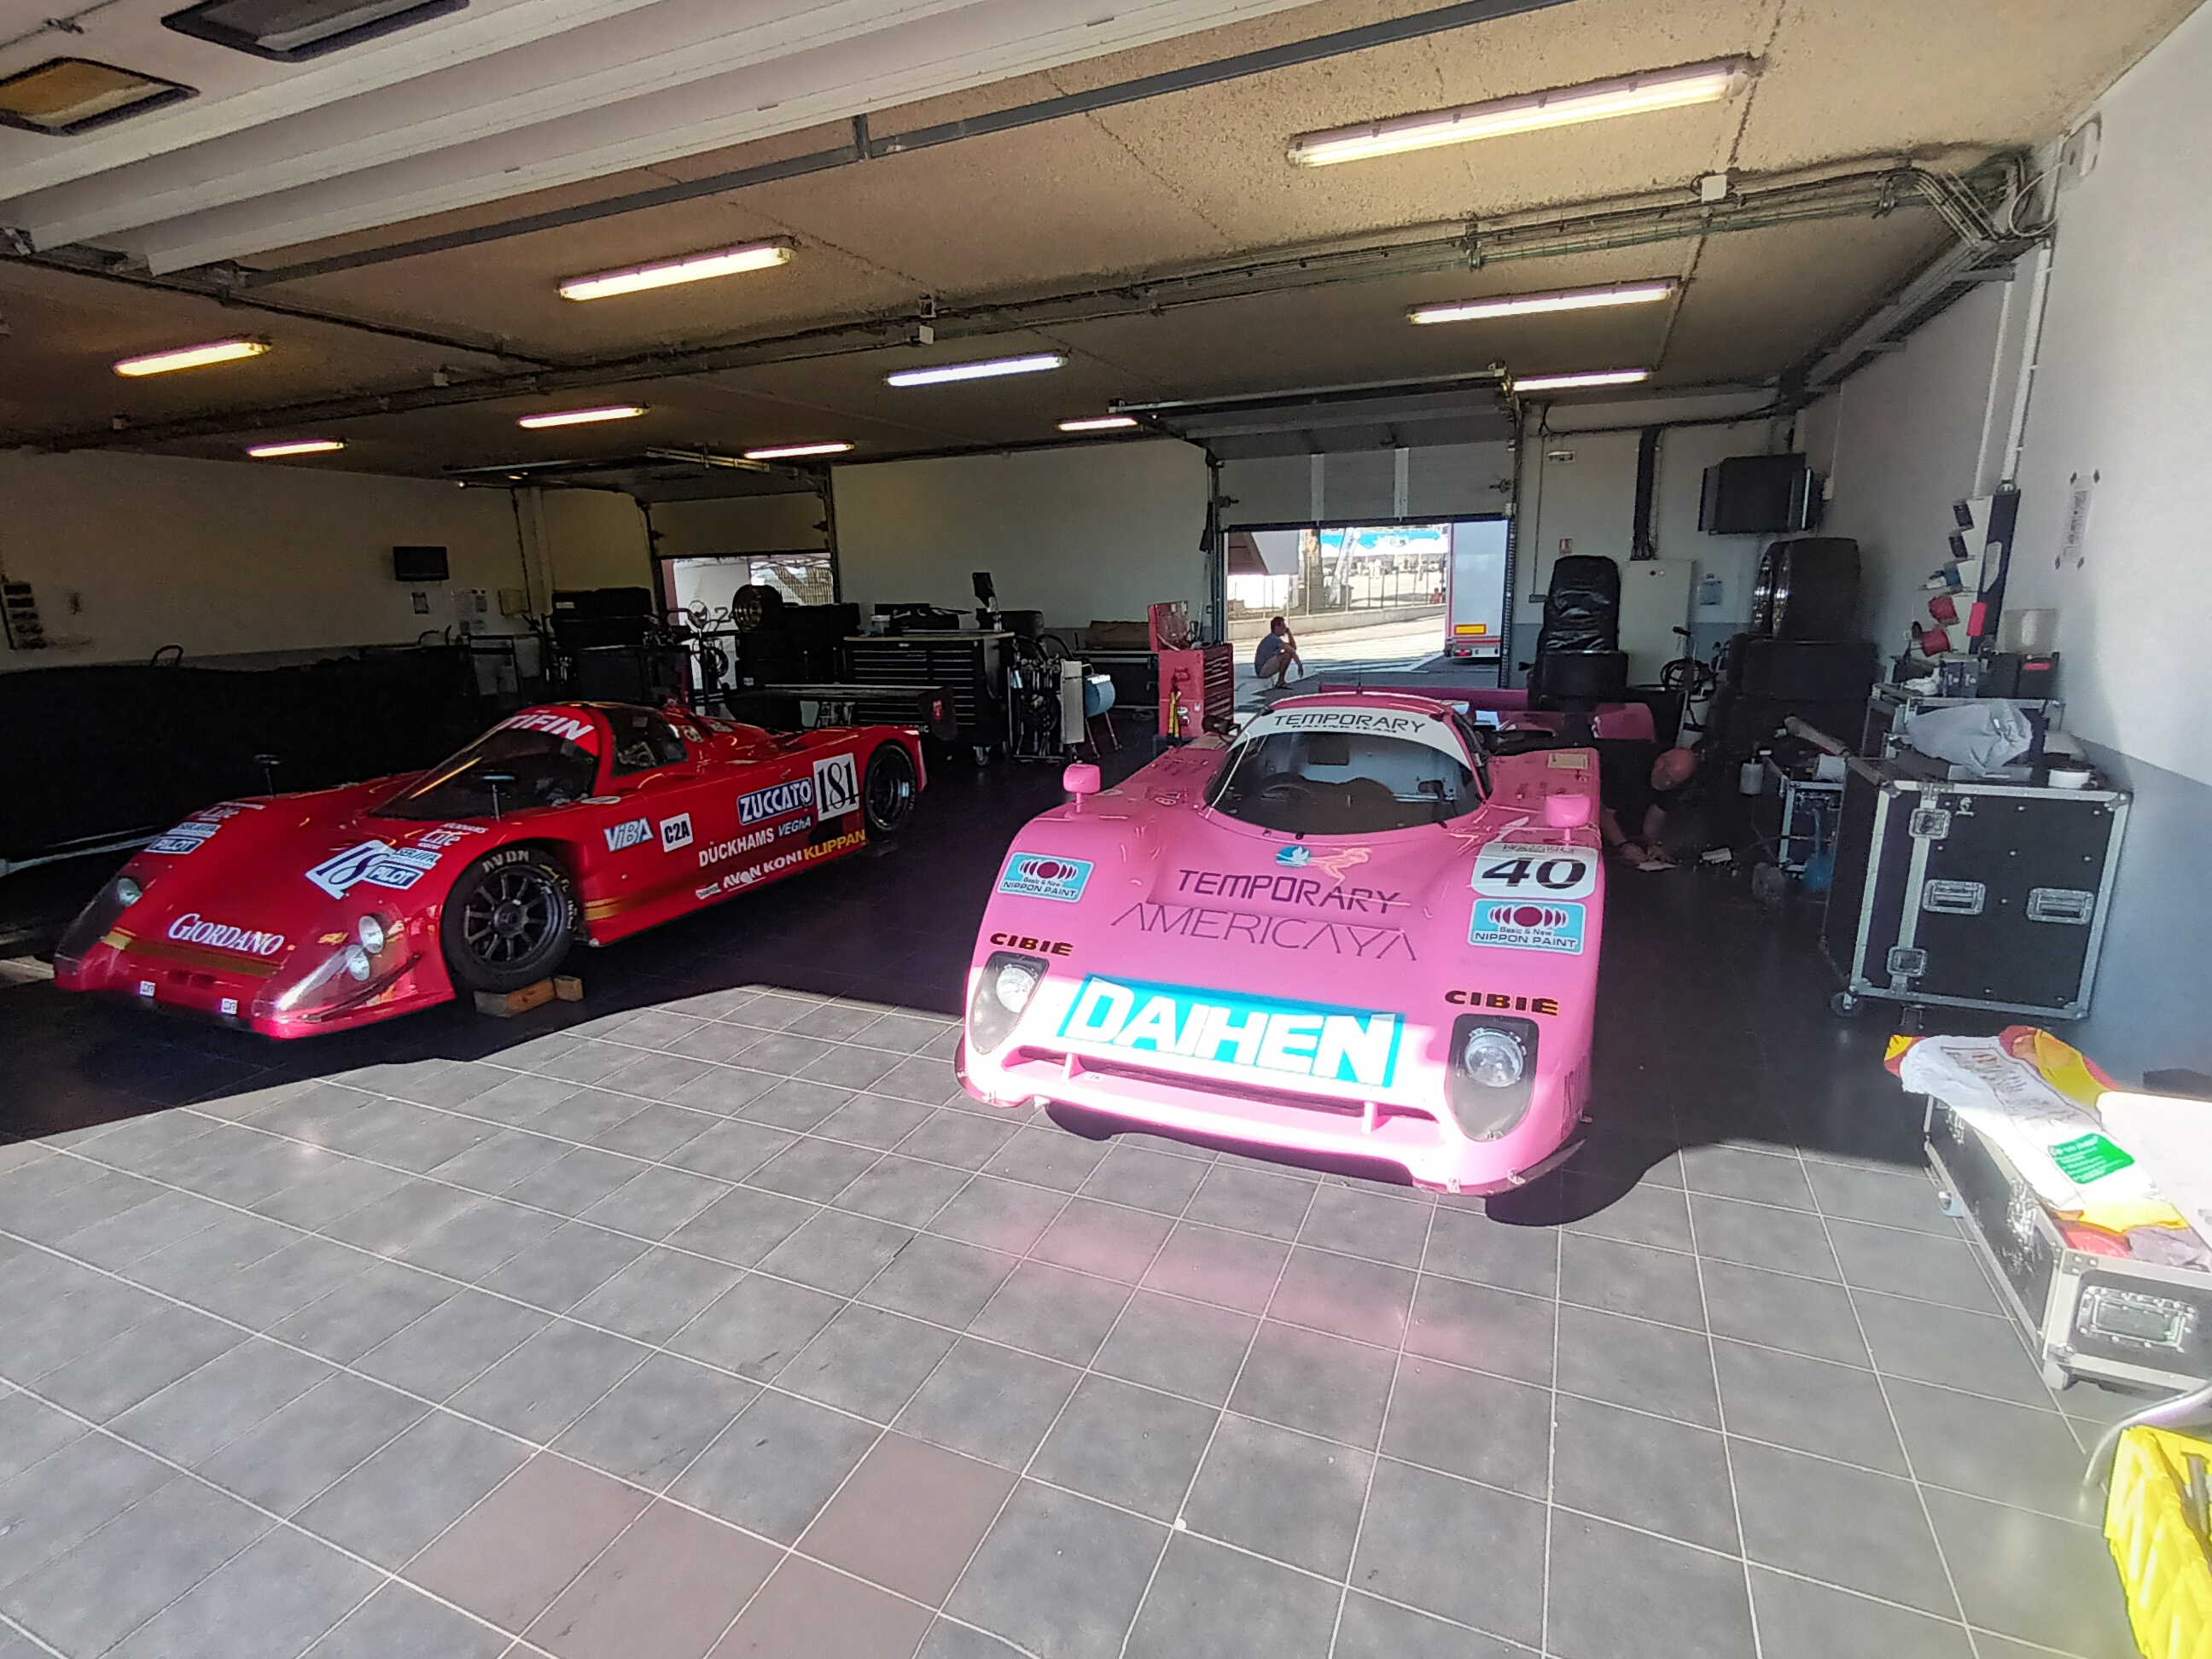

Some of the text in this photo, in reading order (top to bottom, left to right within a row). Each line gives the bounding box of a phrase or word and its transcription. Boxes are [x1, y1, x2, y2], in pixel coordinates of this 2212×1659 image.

[1274, 713, 1426, 733] TEMPORARY
[818, 760, 858, 814] 181
[740, 780, 812, 823] ZUCCATO
[152, 839, 197, 851] PILOT
[664, 820, 690, 844] C2A
[482, 850, 529, 872] AVON
[723, 829, 866, 888] AVON KONI KLIPPAN
[370, 865, 416, 885] PILOT
[1481, 857, 1586, 889] 40
[1003, 882, 1077, 898] NIPPON PAINT
[1178, 869, 1401, 913] TEMPORARY
[168, 913, 285, 956] GIORDANO
[1110, 902, 1417, 961] AMERICAYA
[1475, 932, 1576, 948] NIPPON PAINT
[1499, 926, 1522, 934] Basic
[1064, 976, 1396, 1086] DAIHEN
